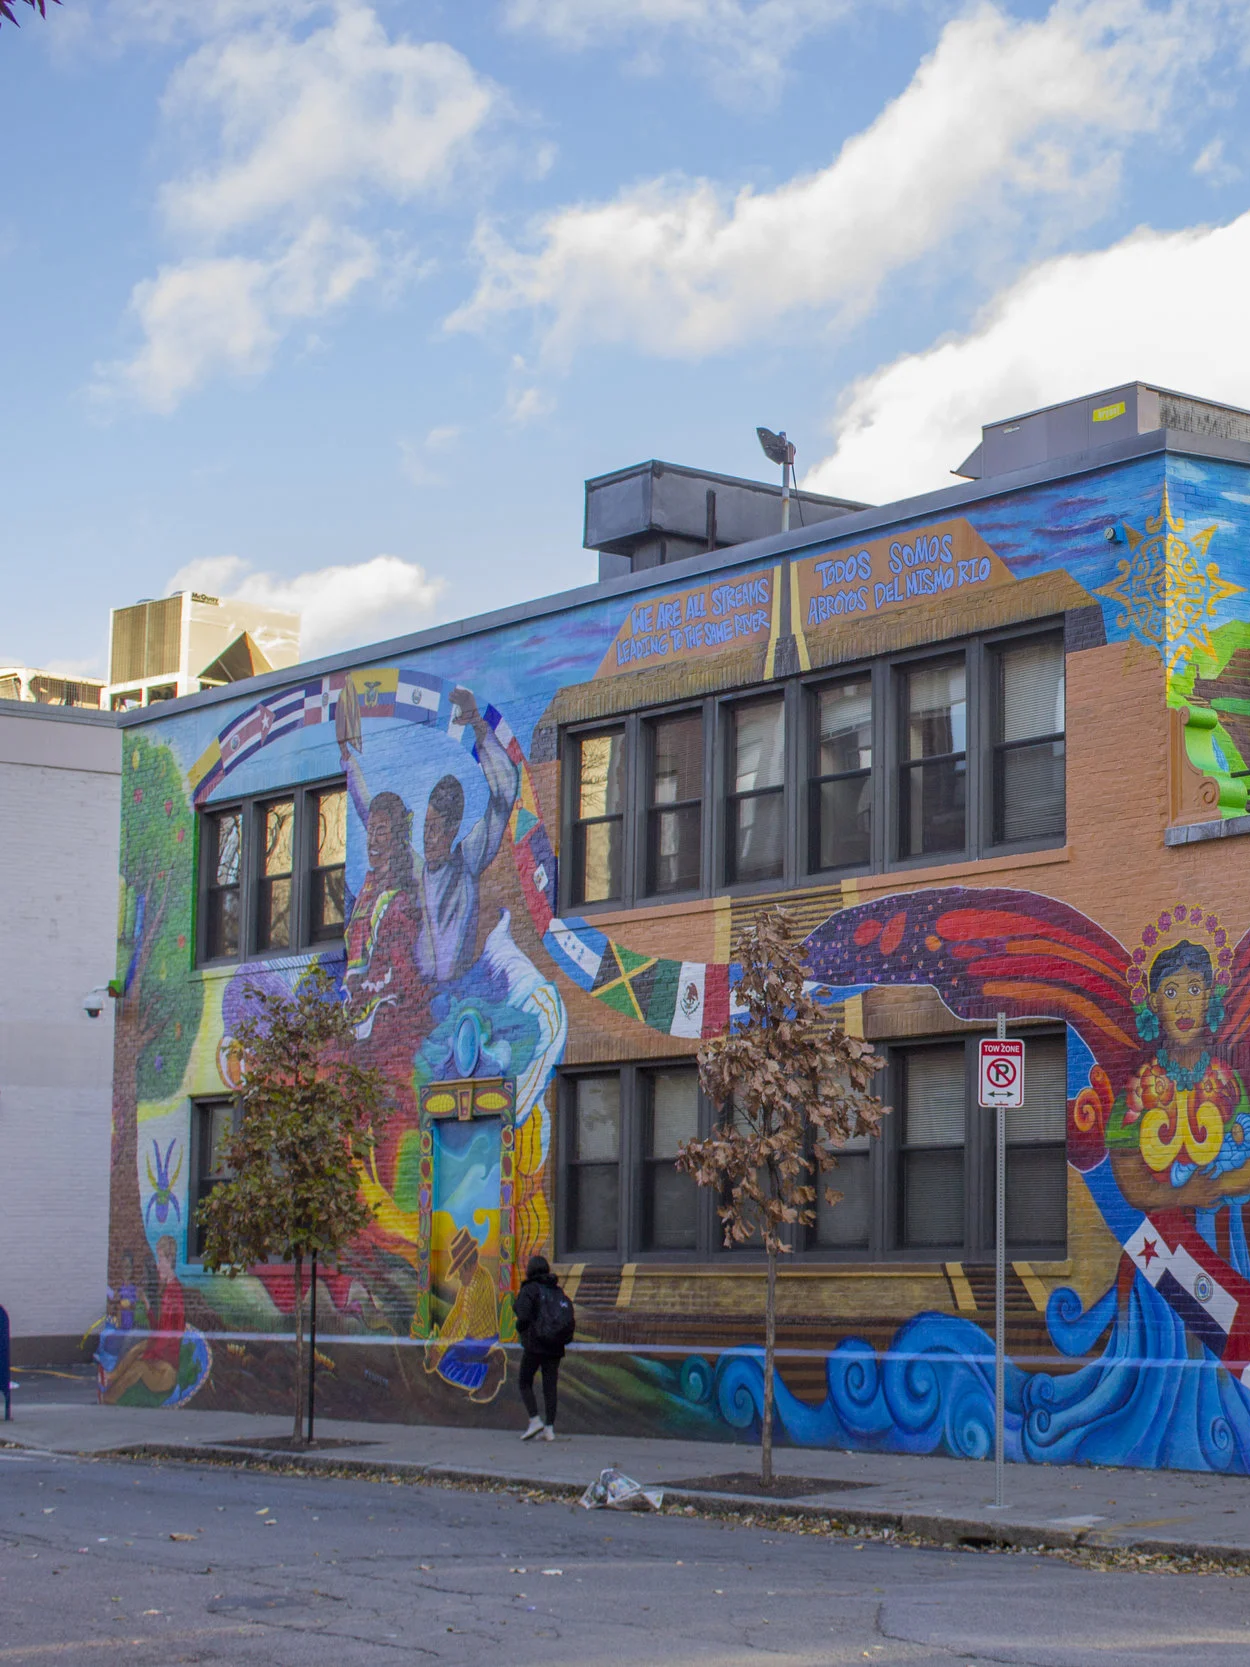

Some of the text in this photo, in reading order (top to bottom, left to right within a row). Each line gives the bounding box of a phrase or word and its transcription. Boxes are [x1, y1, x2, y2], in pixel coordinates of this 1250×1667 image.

[807, 556, 991, 625] ARROYOS DEL MISMO RIO
[814, 534, 953, 590] TODOS SOMOS
[630, 578, 769, 635] WE ARE ALL STREAMS
[616, 608, 770, 667] LEADING TO THE SAME RIVER
[984, 1045, 1020, 1053] TOW ZONE
